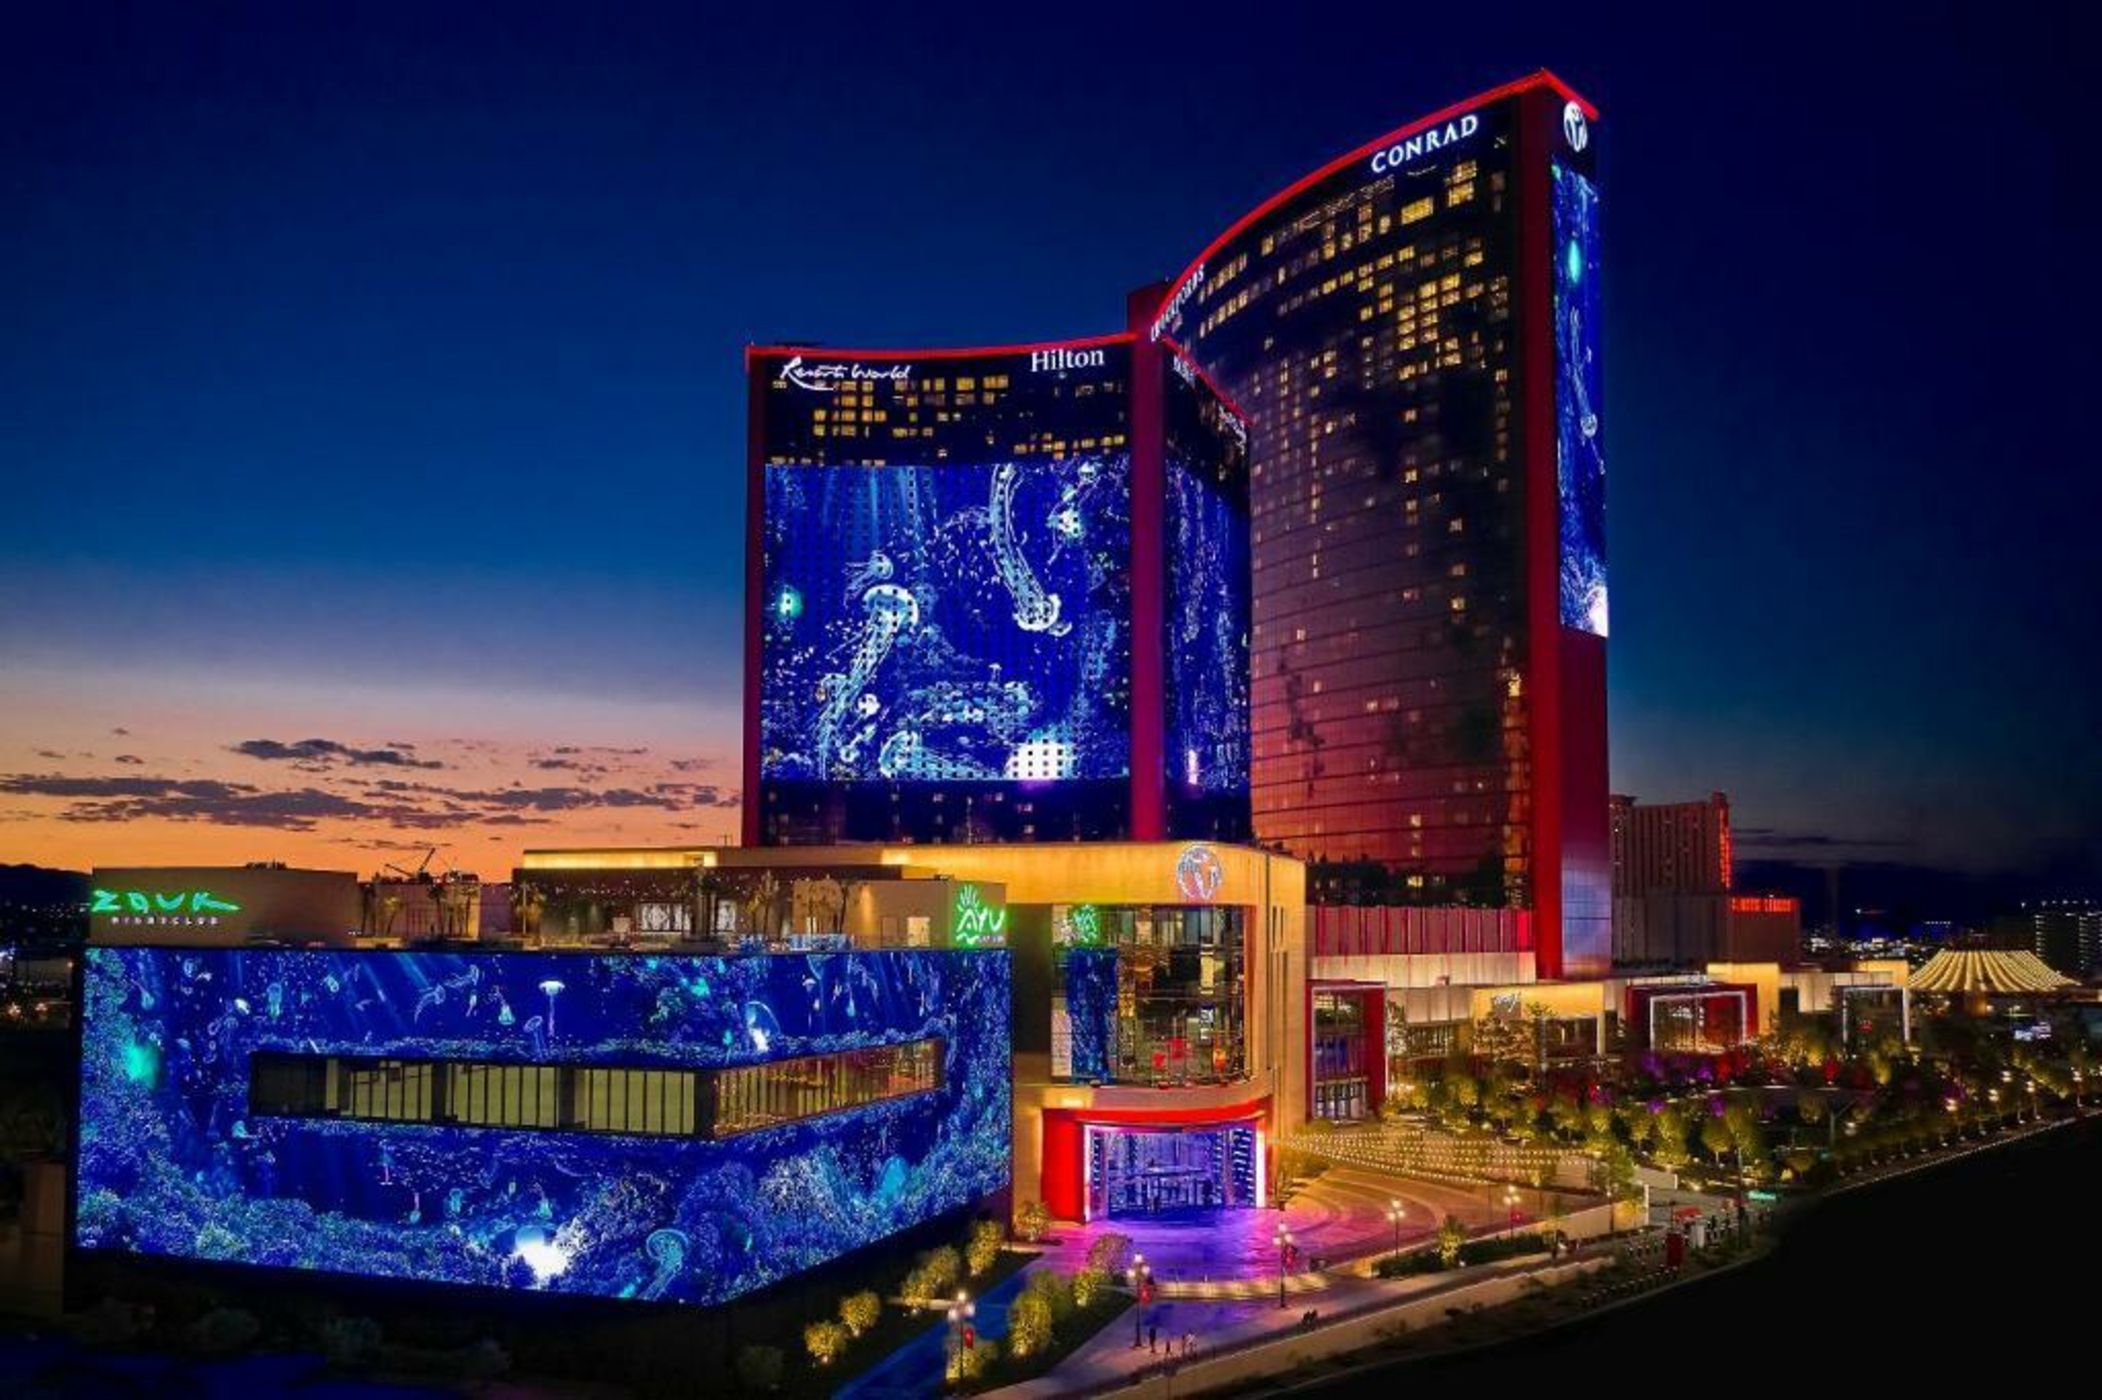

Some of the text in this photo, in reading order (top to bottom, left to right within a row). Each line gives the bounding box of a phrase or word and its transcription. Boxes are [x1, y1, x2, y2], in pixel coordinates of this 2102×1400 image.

[1370, 113, 1479, 174] CONRAD
[851, 363, 912, 380] World
[1030, 348, 1105, 373] Hilton
[90, 889, 241, 914] ZOUK
[955, 906, 1006, 933] AYU
